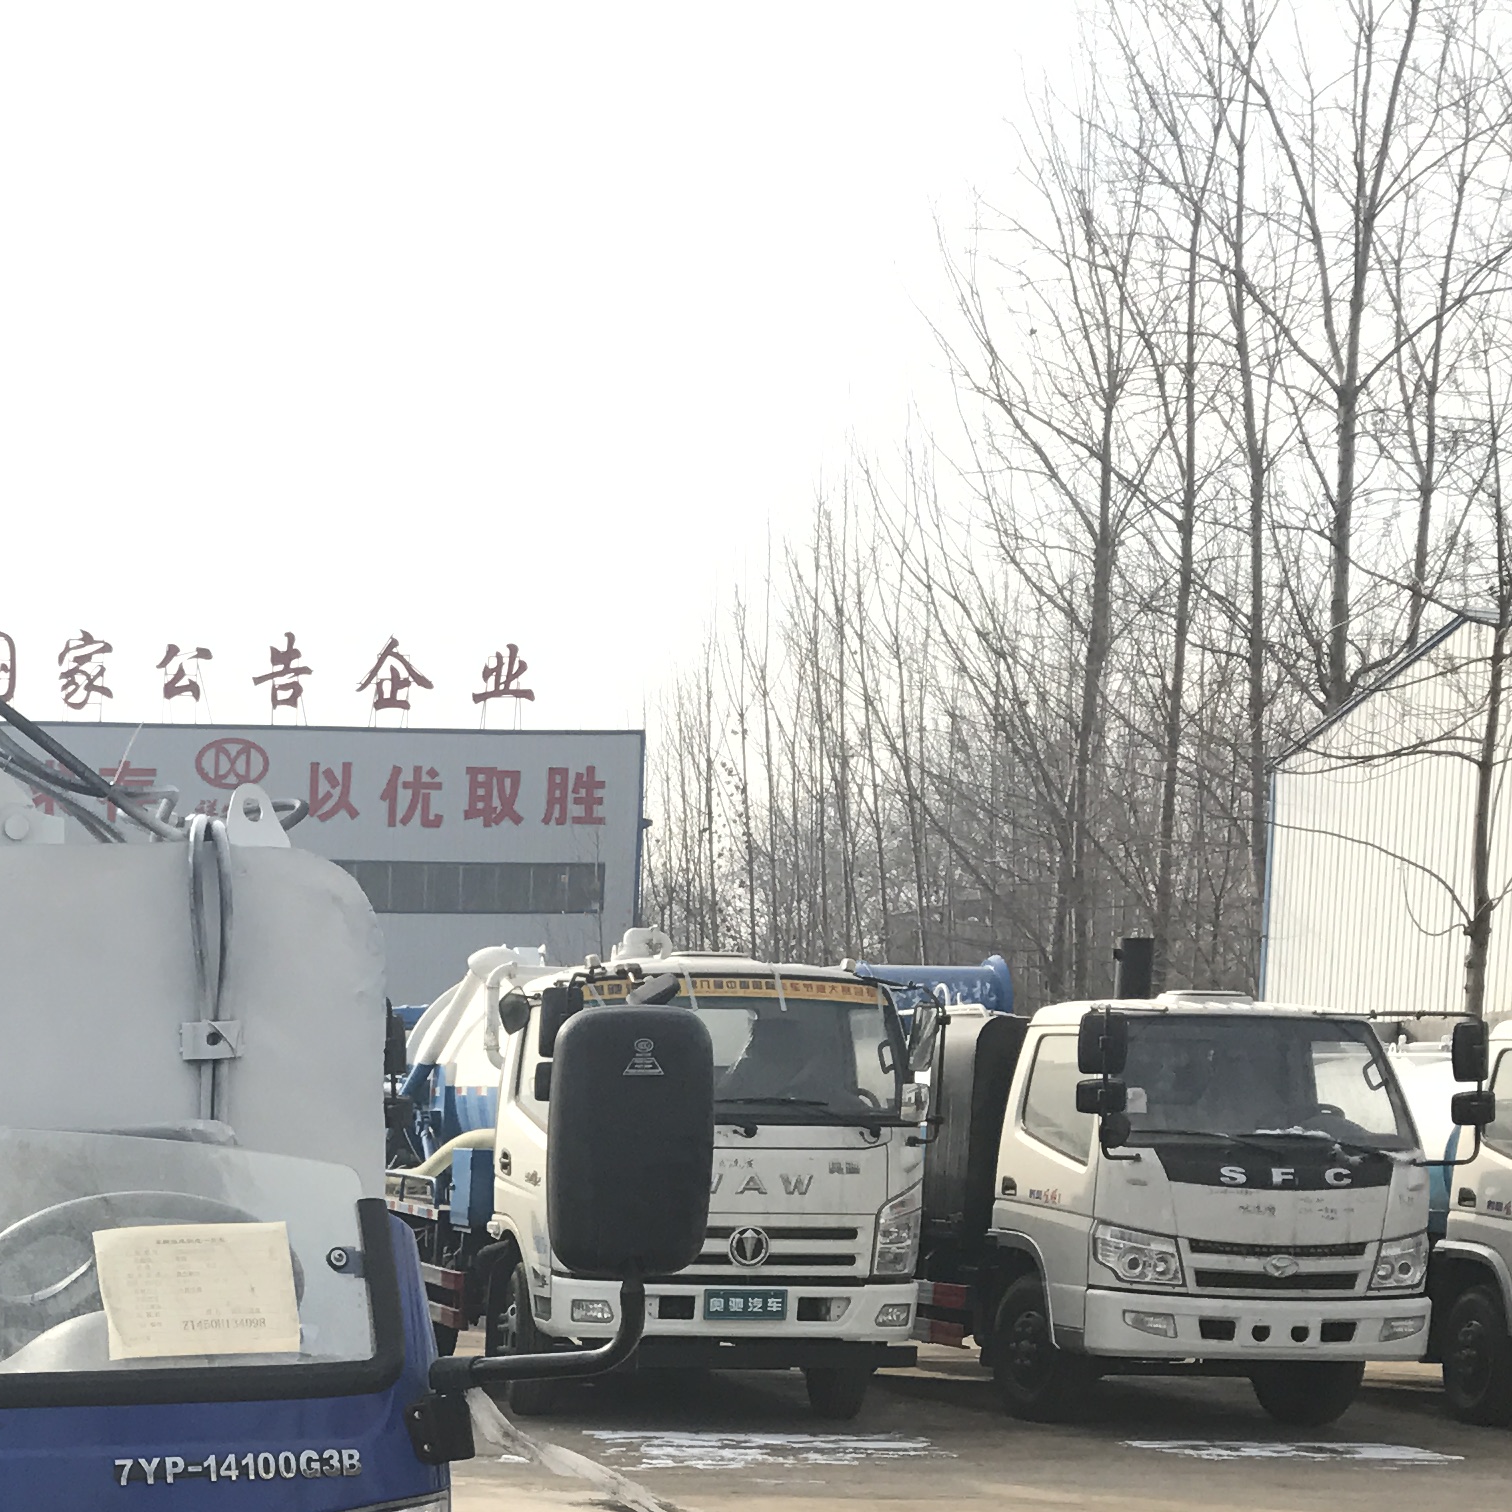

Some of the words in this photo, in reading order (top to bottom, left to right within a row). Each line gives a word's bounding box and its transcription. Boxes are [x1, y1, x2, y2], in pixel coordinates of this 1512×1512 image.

[308, 762, 606, 828] 以优取胜
[710, 1173, 814, 1196] AW
[1220, 1166, 1353, 1187] SFC
[114, 1449, 362, 1486] 7YP-14100G3B
